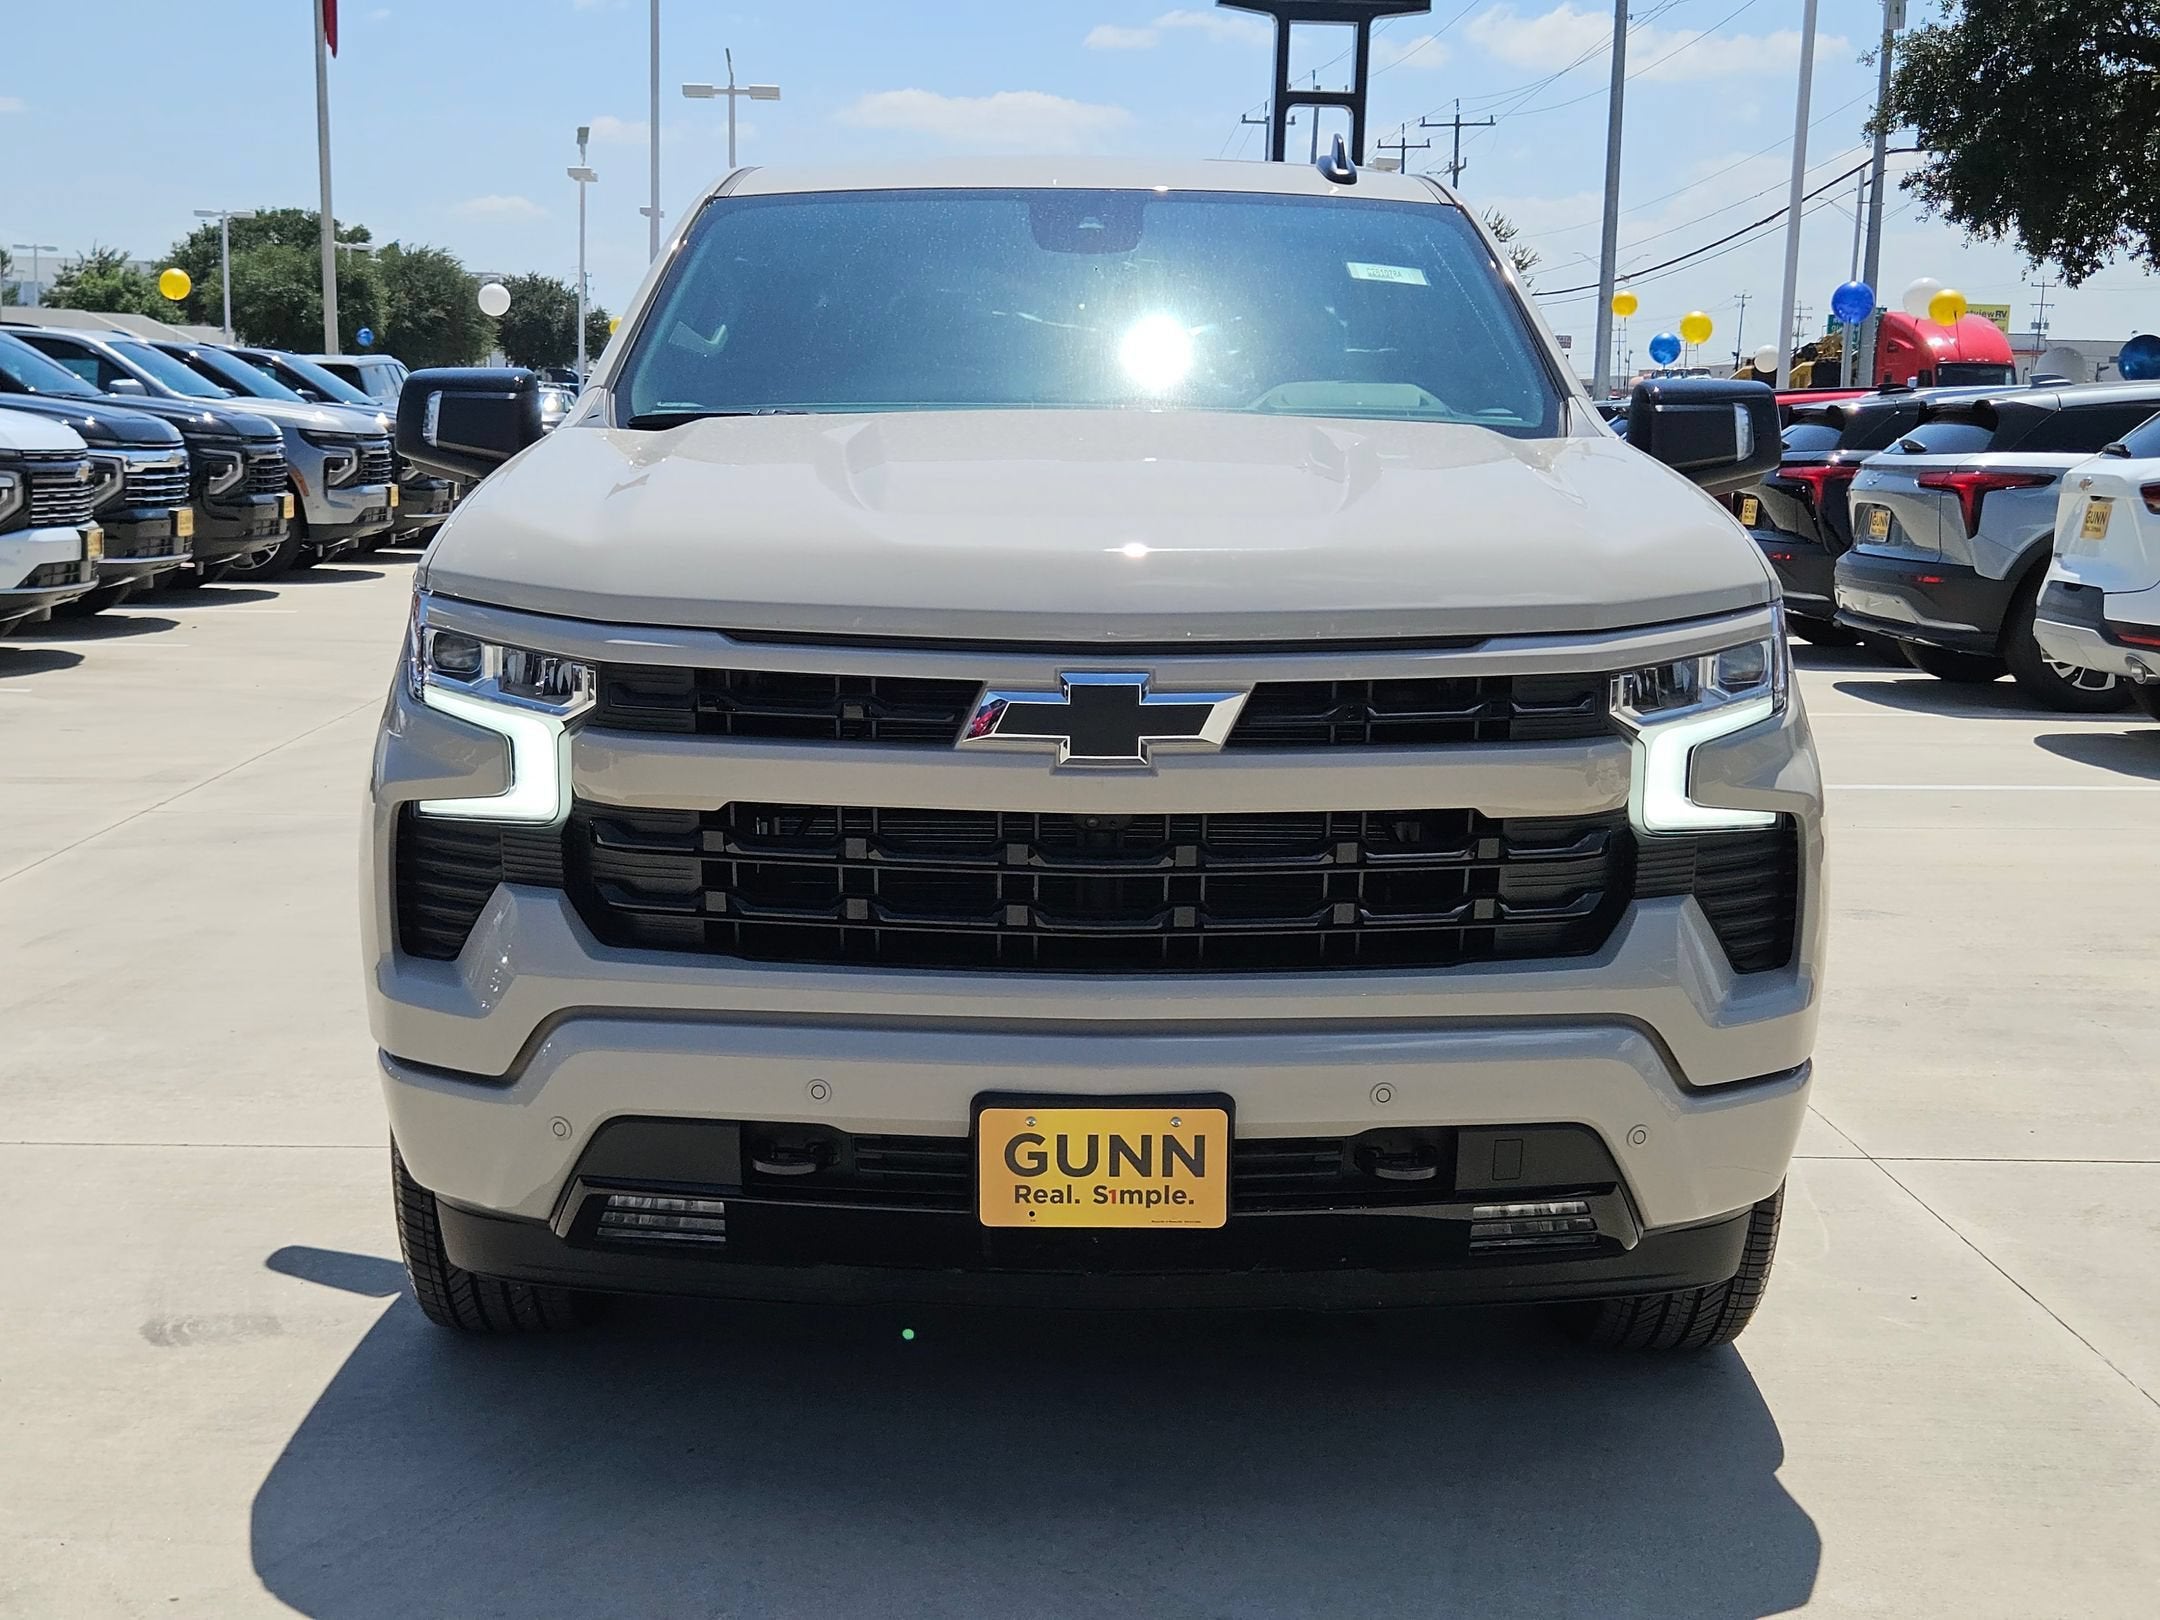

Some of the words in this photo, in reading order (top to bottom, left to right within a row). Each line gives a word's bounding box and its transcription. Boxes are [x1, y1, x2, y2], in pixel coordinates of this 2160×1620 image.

[2085, 510, 2108, 525] GUNN
[1004, 1132, 1205, 1178] GUNN
[1014, 1184, 1081, 1205] Real.
